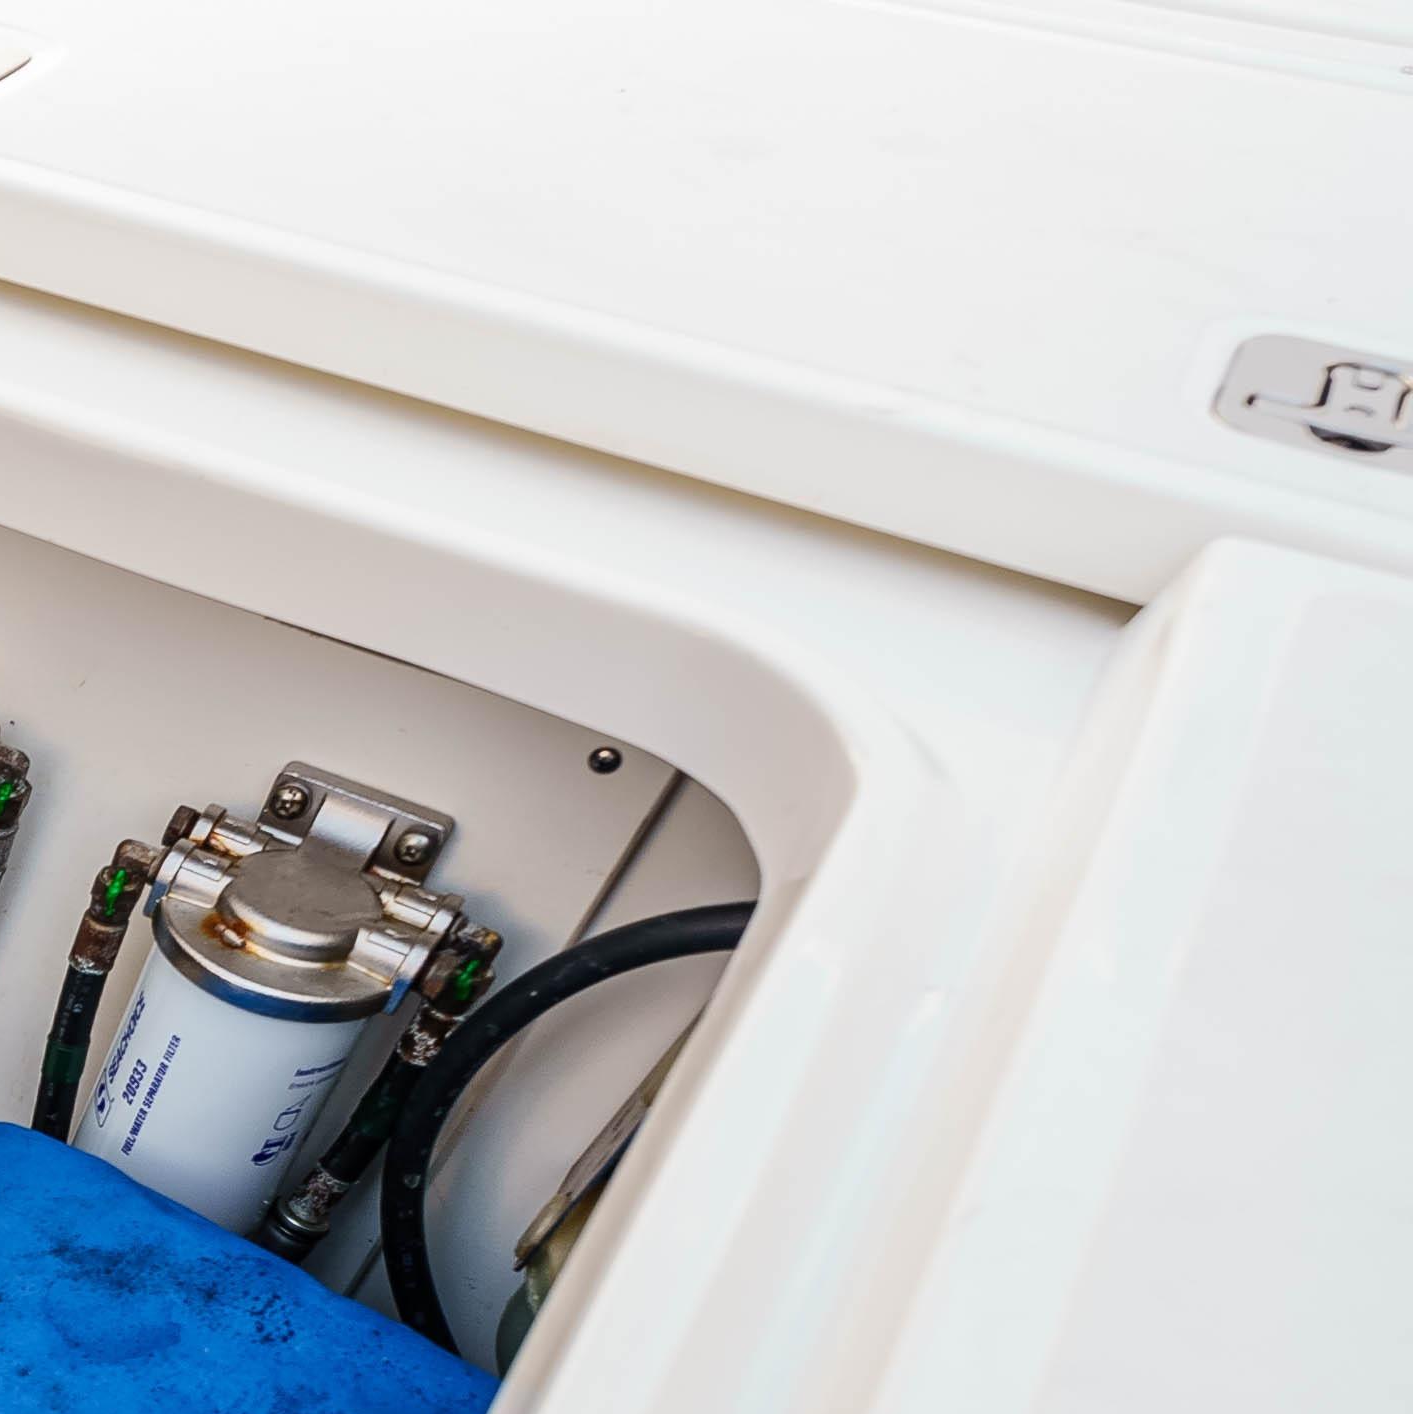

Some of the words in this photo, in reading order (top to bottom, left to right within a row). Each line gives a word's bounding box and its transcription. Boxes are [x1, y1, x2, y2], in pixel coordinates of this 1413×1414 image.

[108, 990, 146, 1085] SEACHOICE
[122, 1058, 148, 1106] 20933
[121, 1107, 150, 1156] FUEL/WATER
[142, 1061, 169, 1111] SEPARATOR
[166, 1034, 182, 1067] FILTER
